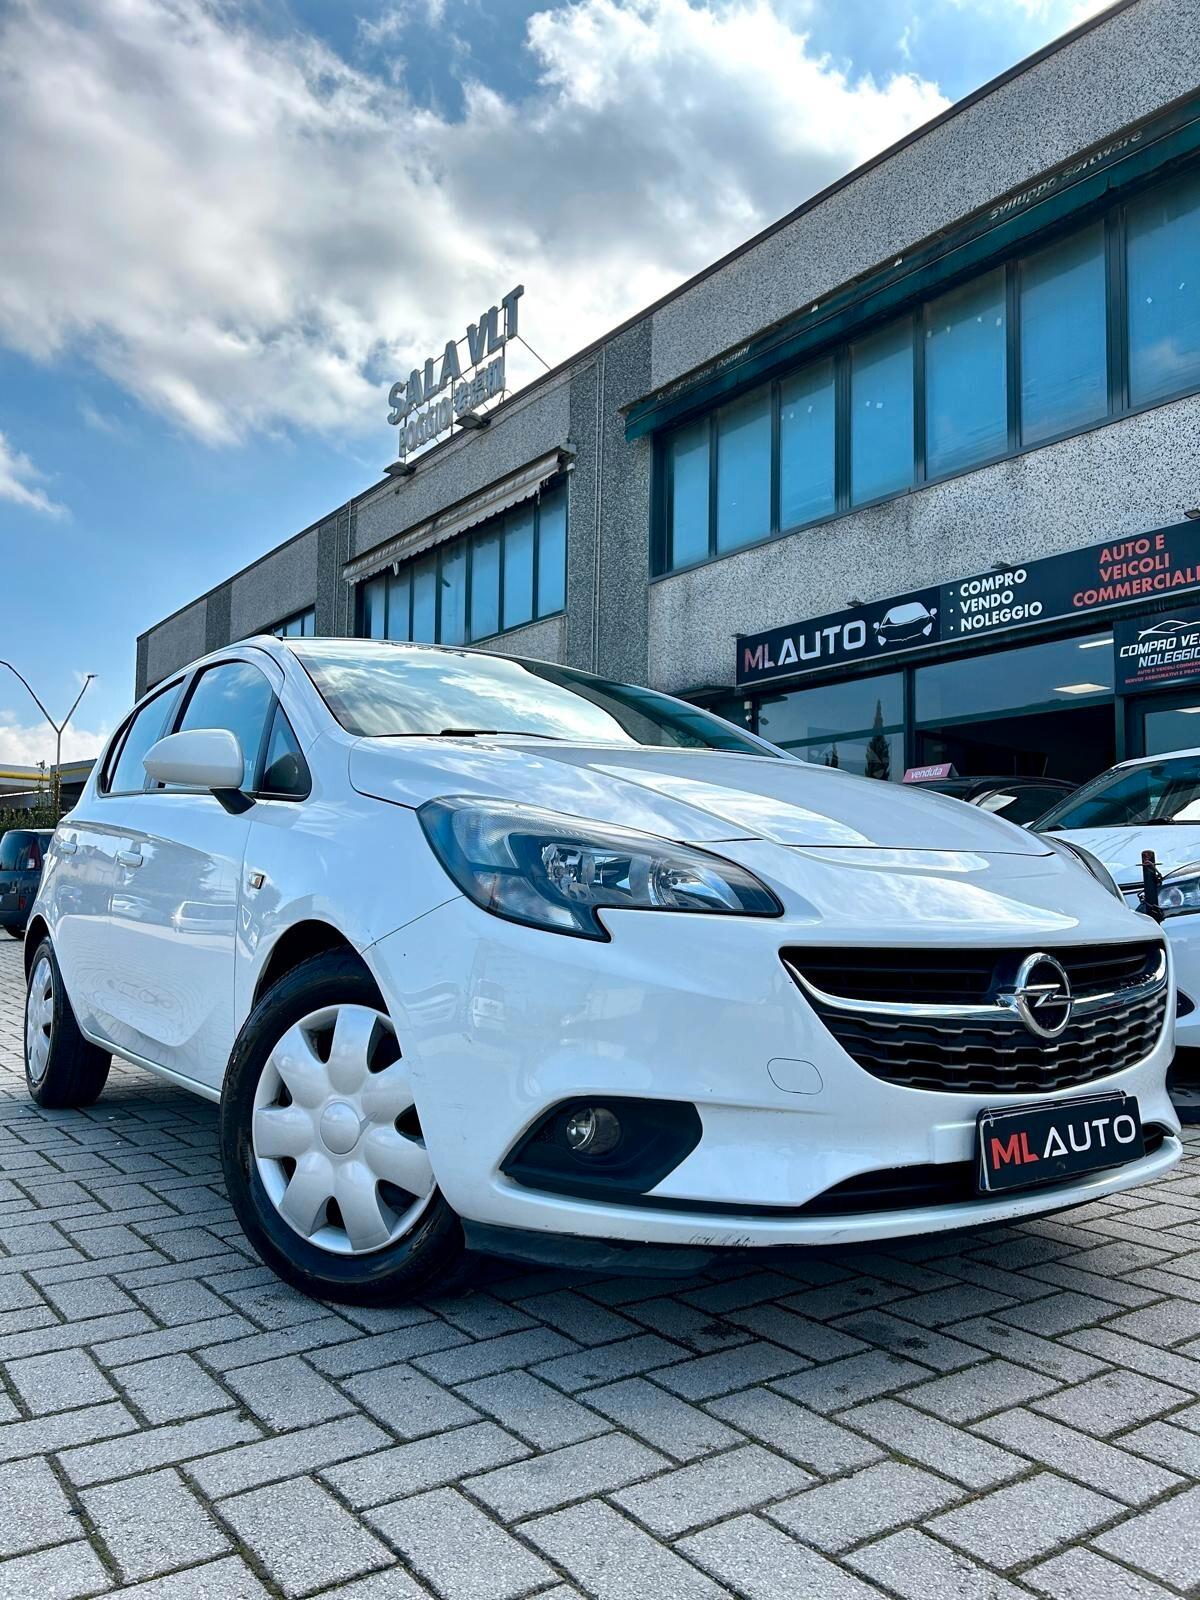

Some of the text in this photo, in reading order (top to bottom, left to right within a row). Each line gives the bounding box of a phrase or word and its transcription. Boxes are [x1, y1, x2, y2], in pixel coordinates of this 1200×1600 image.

[387, 284, 525, 426] SALA VLT
[398, 396, 454, 458] POGGIO
[1099, 534, 1165, 565] AUTO E
[959, 568, 1028, 597] COMPRO
[1099, 552, 1171, 583] VEICOLI
[959, 590, 1015, 615] VENDO
[960, 601, 1043, 633] NOLEGGIO
[1119, 633, 1200, 658] COMPRO VE
[911, 766, 943, 779] venduta
[991, 1114, 1136, 1170] ML AUTO
